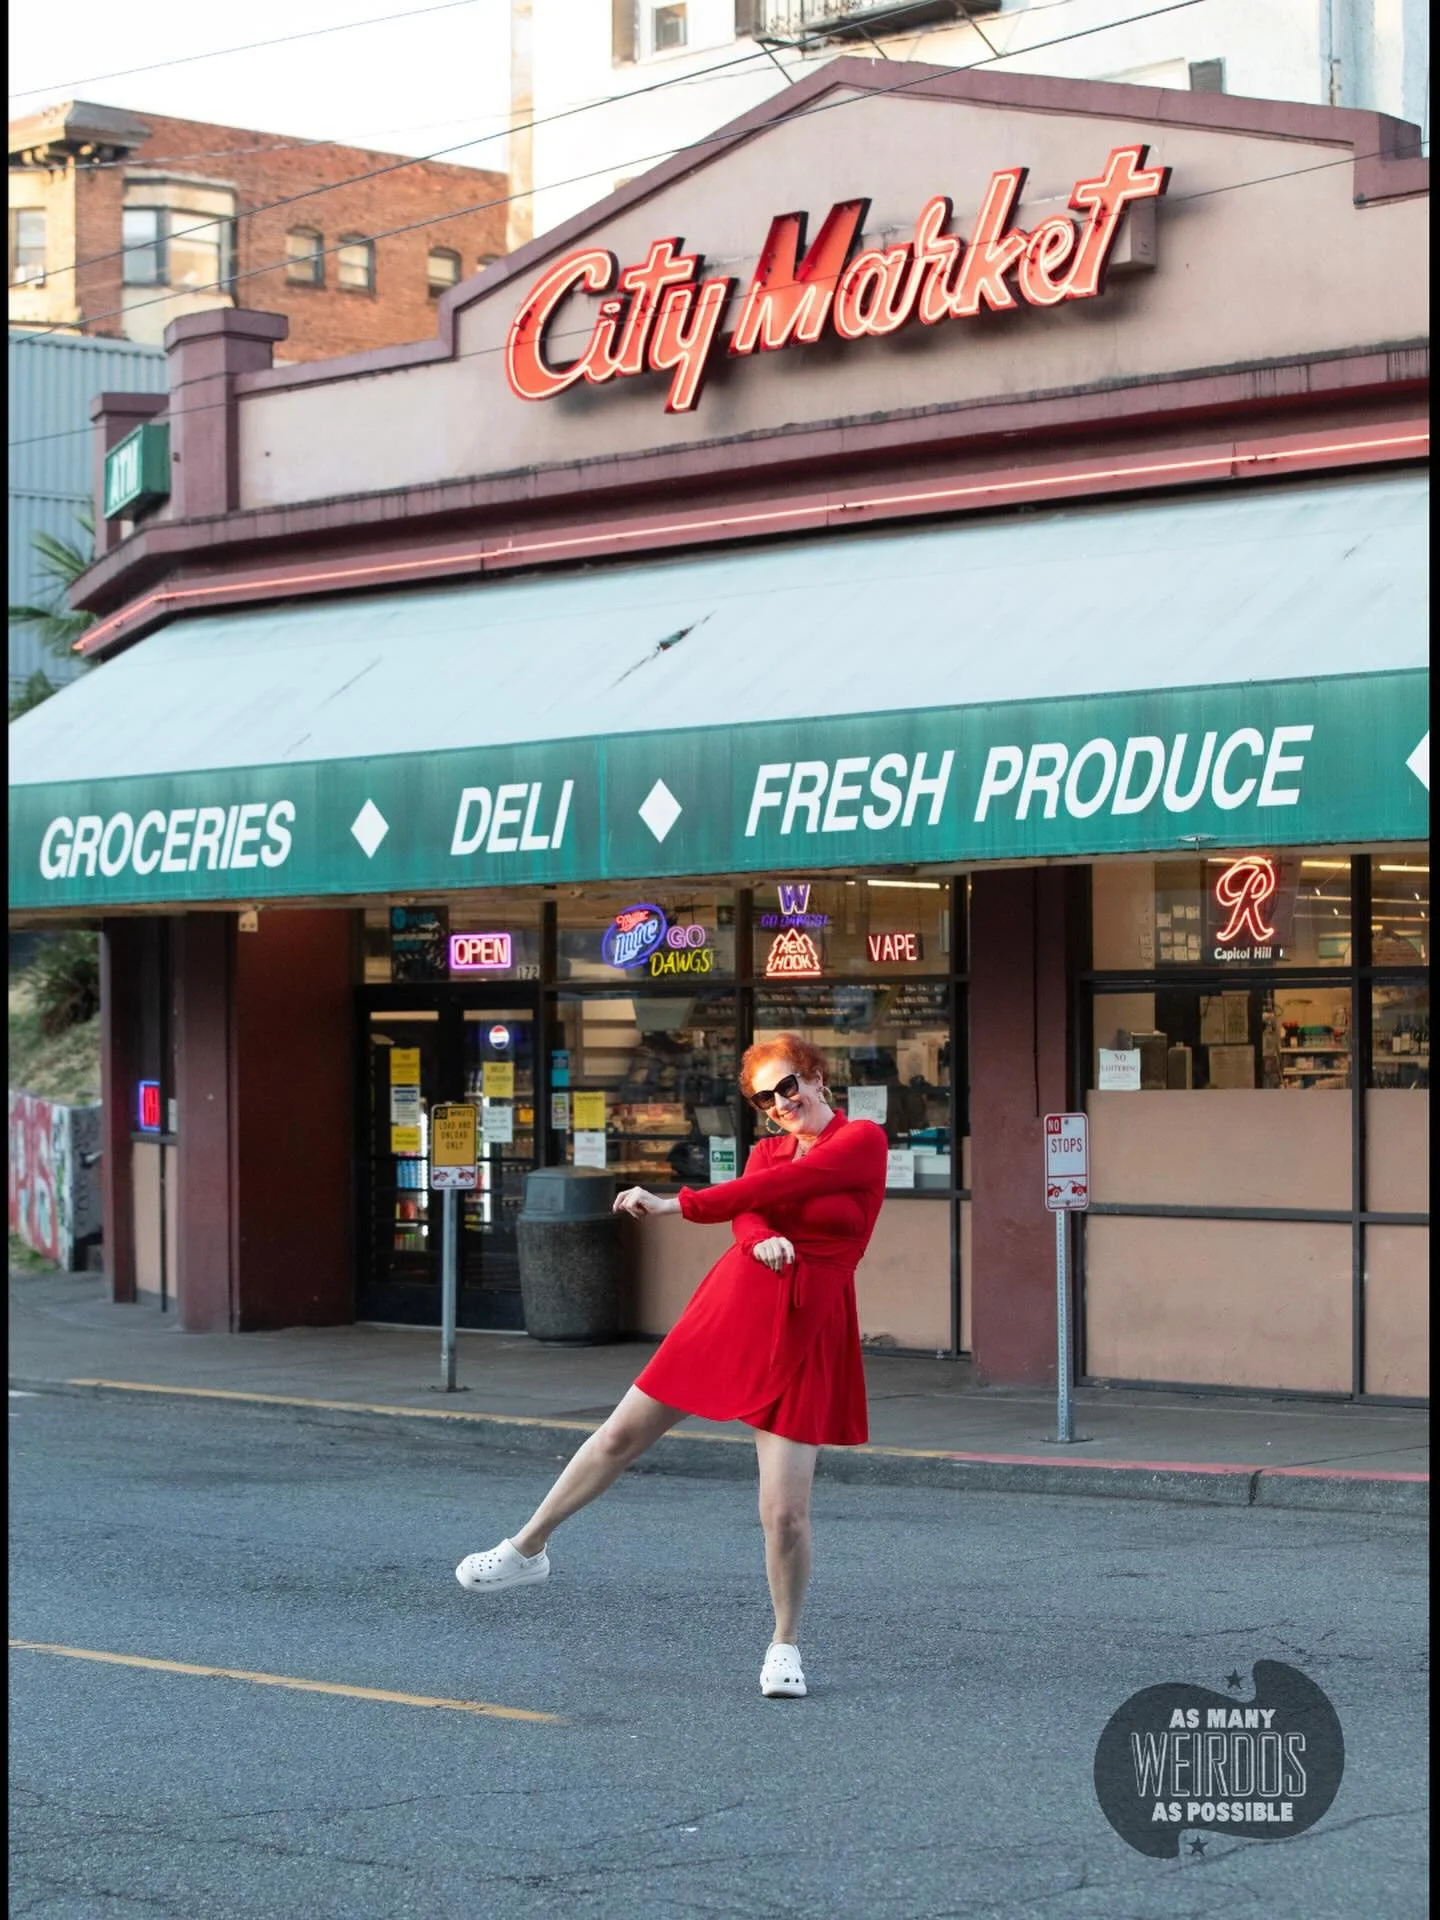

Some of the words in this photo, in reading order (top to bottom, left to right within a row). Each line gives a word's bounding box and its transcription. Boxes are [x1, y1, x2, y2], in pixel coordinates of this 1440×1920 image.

[507, 237, 736, 414] City
[727, 144, 1172, 356] Market
[745, 750, 954, 837] FRESH
[974, 724, 1314, 822] PRODUCE
[451, 780, 574, 855] DELI
[39, 800, 296, 880] GROCERIES
[777, 884, 811, 915] W
[666, 925, 706, 948] GO
[778, 940, 807, 954] RED
[868, 934, 917, 961] VAPE
[455, 938, 508, 965] OPEN
[772, 955, 813, 970] HOOK
[1213, 947, 1250, 960] Capitol
[1253, 947, 1272, 959] Hill
[1114, 1053, 1127, 1062] NO
[439, 1121, 456, 1130] LOAD
[1047, 1119, 1060, 1132] NO
[1051, 1138, 1083, 1153] STOPS
